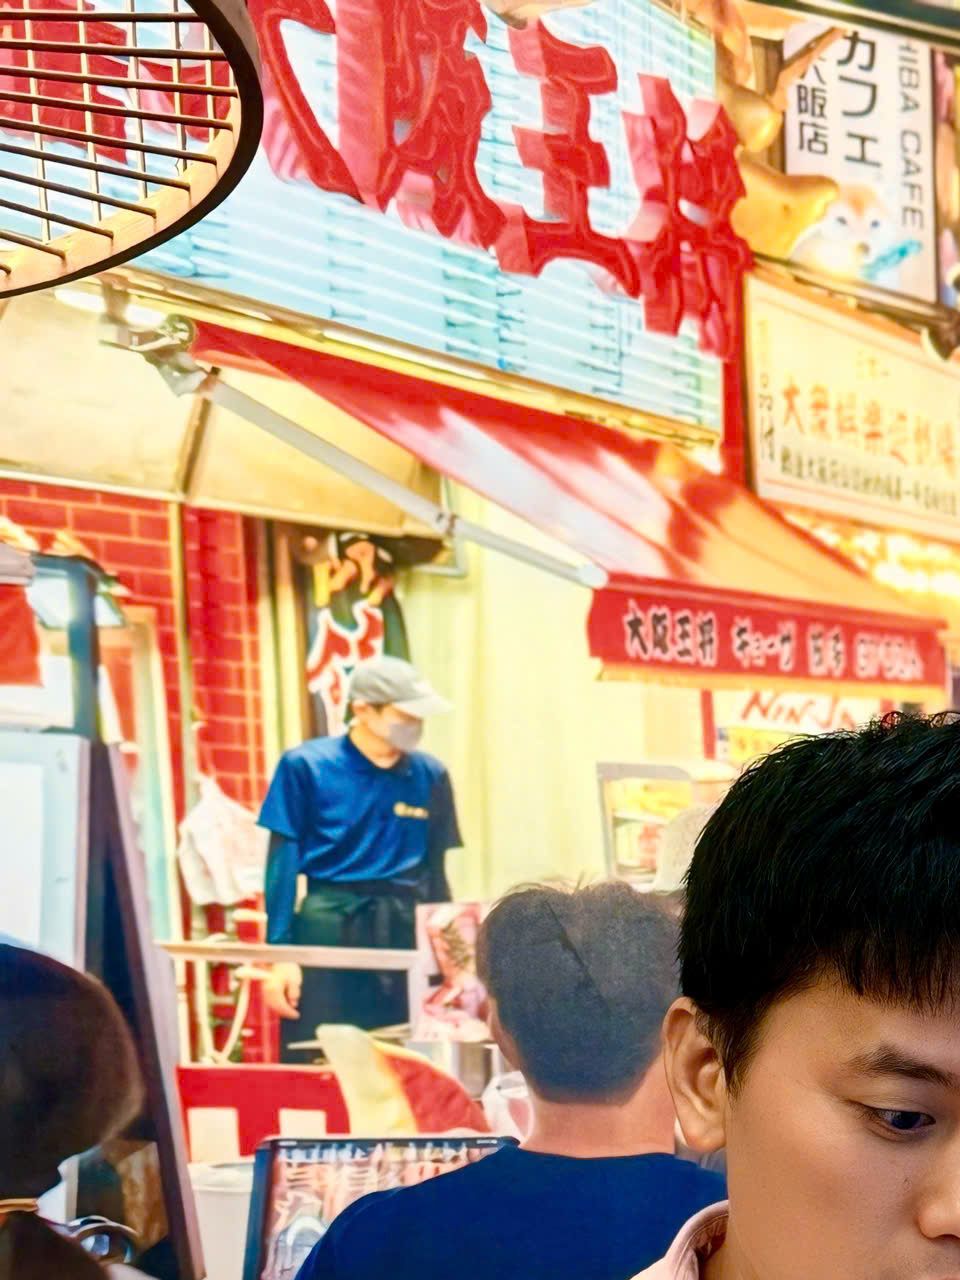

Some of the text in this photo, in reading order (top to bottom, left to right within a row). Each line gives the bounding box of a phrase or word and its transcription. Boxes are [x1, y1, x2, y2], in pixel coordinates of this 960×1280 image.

[899, 130, 923, 230] CAFE
[623, 600, 719, 667] 大阪王将
